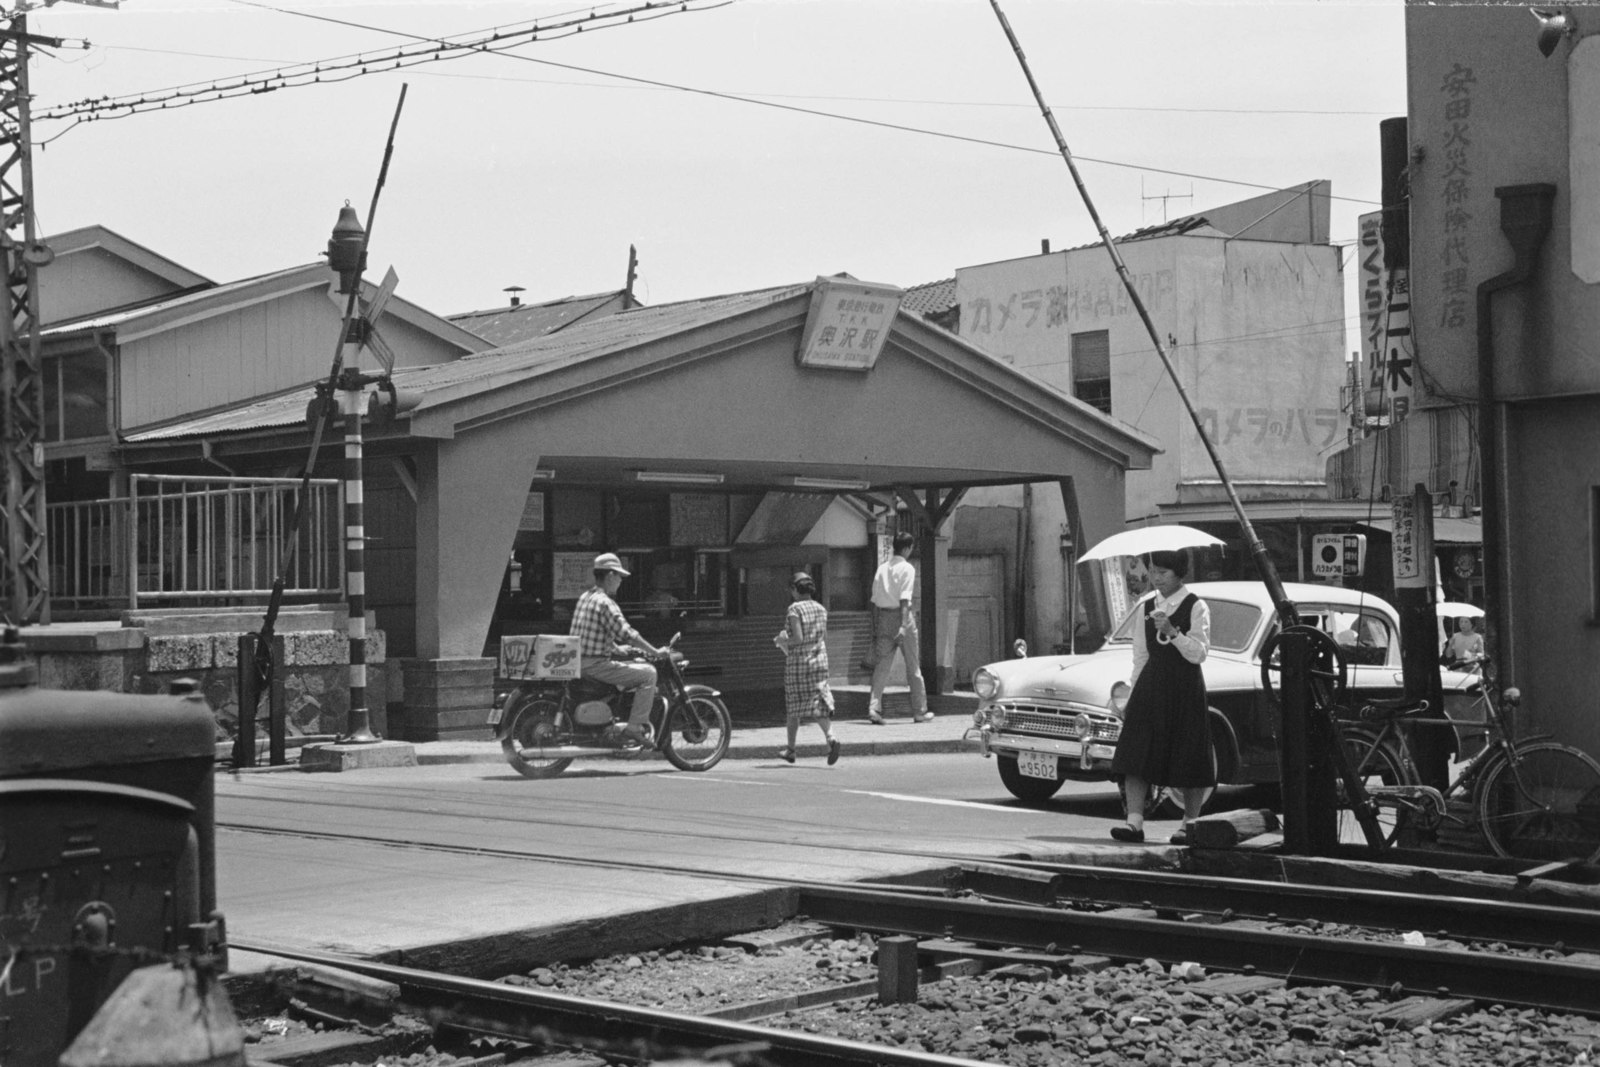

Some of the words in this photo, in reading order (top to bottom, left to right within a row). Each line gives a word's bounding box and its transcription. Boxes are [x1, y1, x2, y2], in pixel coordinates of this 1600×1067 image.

[1440, 62, 1477, 329] 安田火災保険代理店
[818, 325, 879, 350] 奥沢駅
[1027, 762, 1055, 778] 9502
